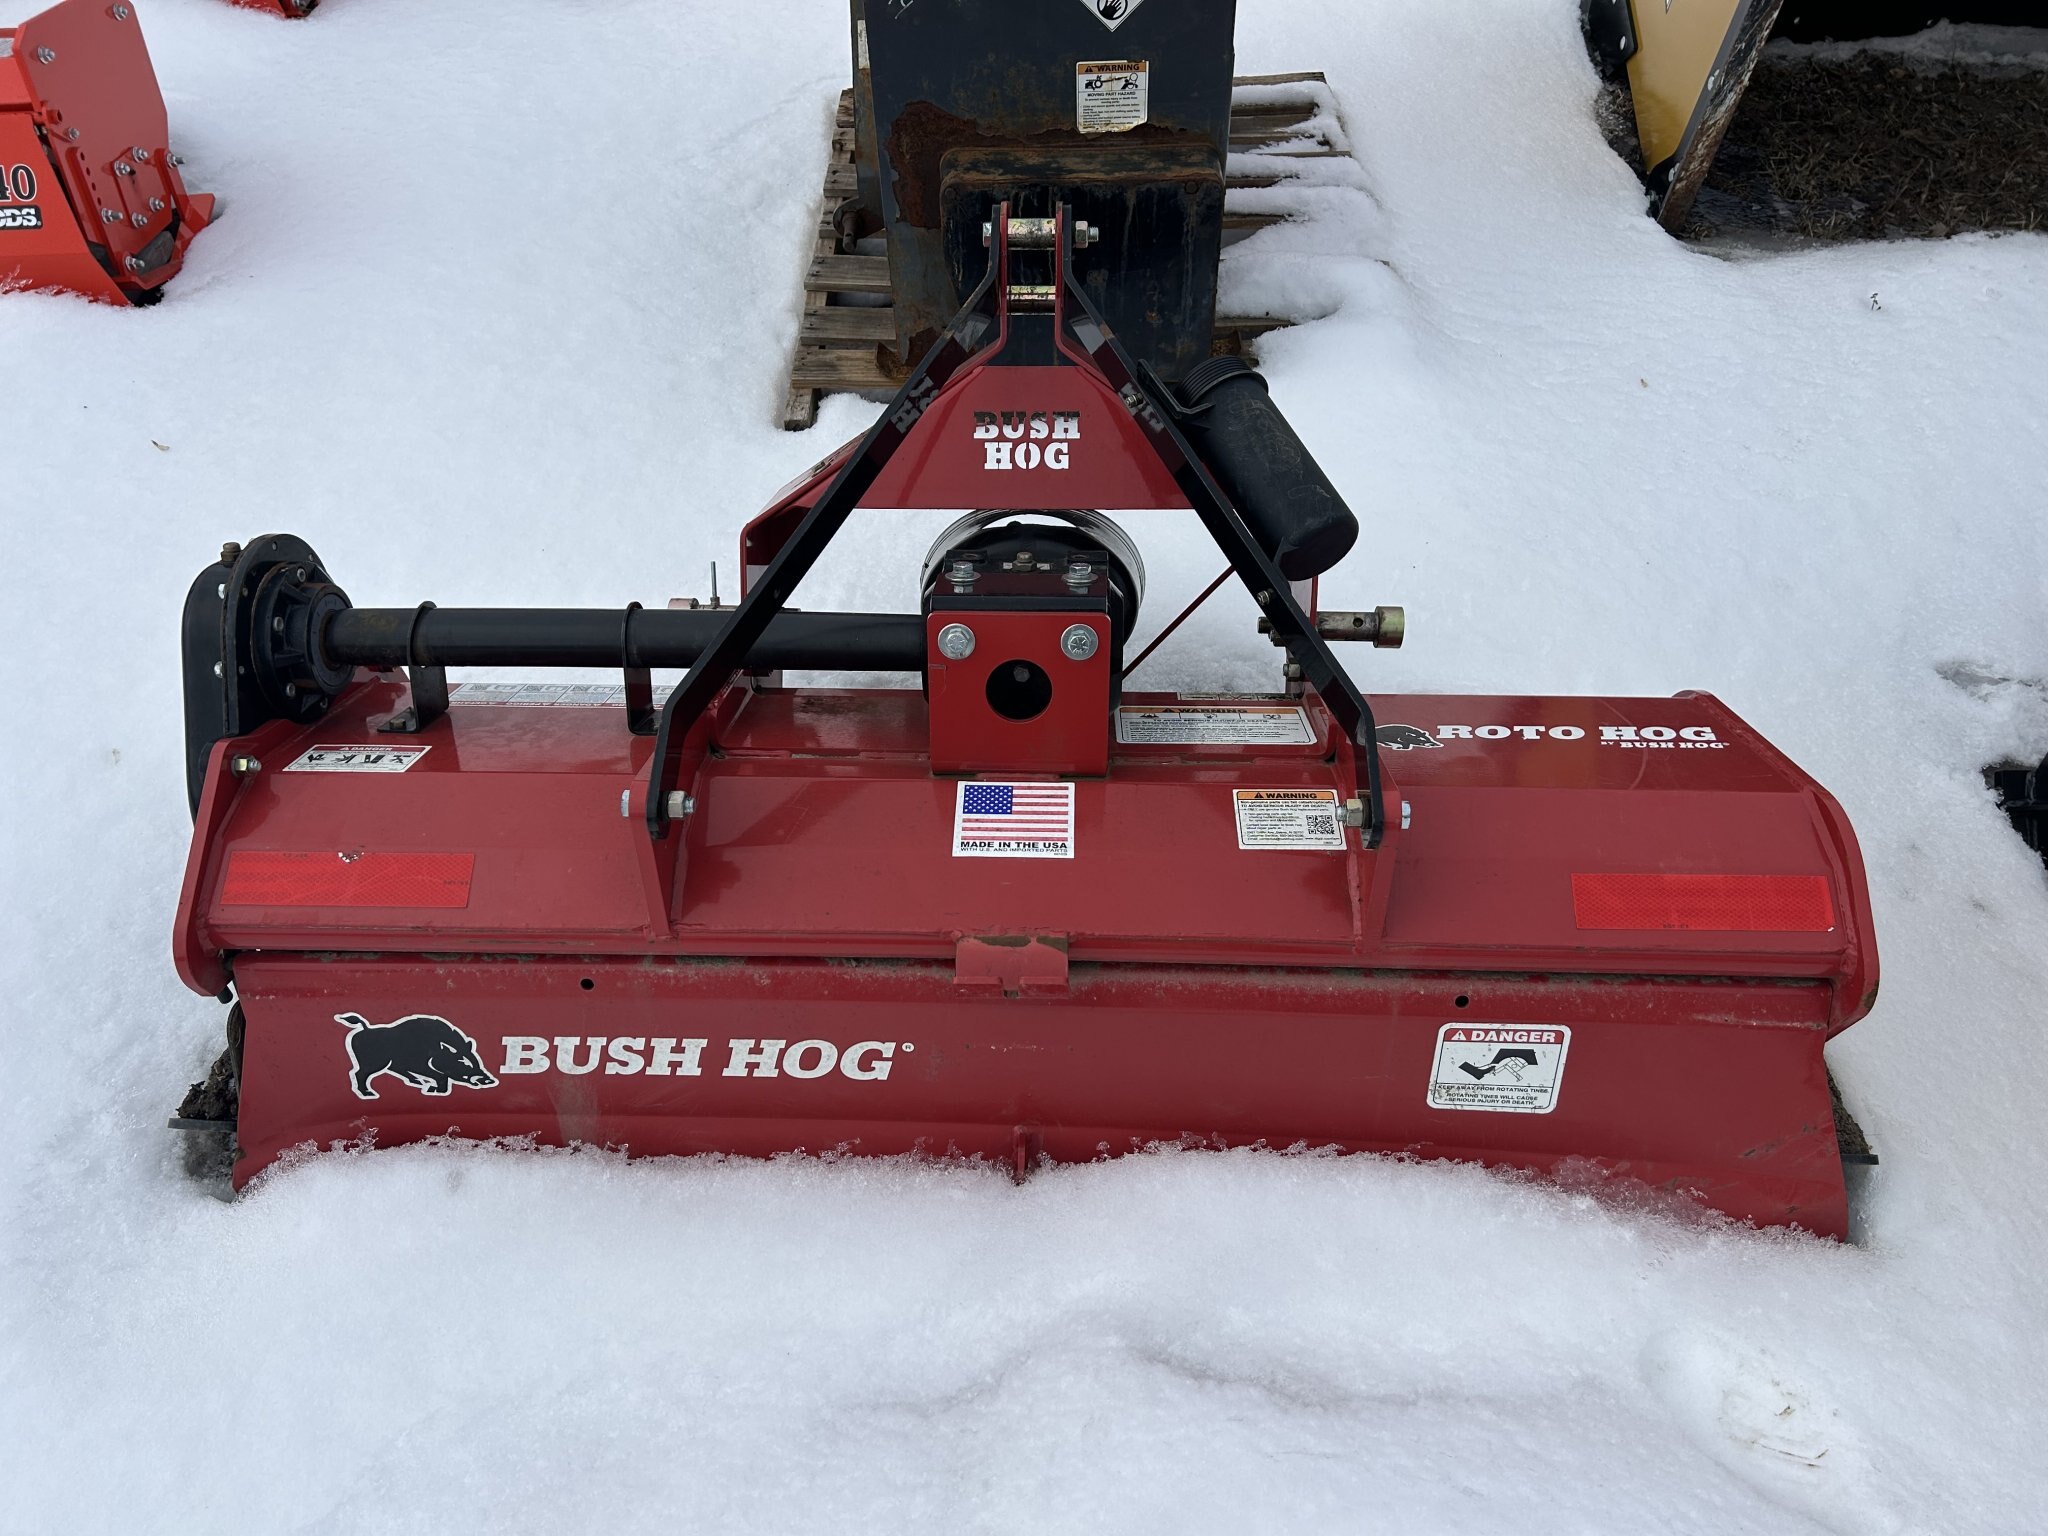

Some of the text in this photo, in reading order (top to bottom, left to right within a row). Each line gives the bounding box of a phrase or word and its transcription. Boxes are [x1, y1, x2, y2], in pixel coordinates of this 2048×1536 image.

[1097, 64, 1139, 72] WARNING
[973, 411, 1081, 439] BUSH
[984, 442, 1070, 470] HOG
[1436, 725, 1717, 740] ROTO HOG
[1470, 1030, 1556, 1043] DANGER
[499, 1036, 708, 1076] BUSH
